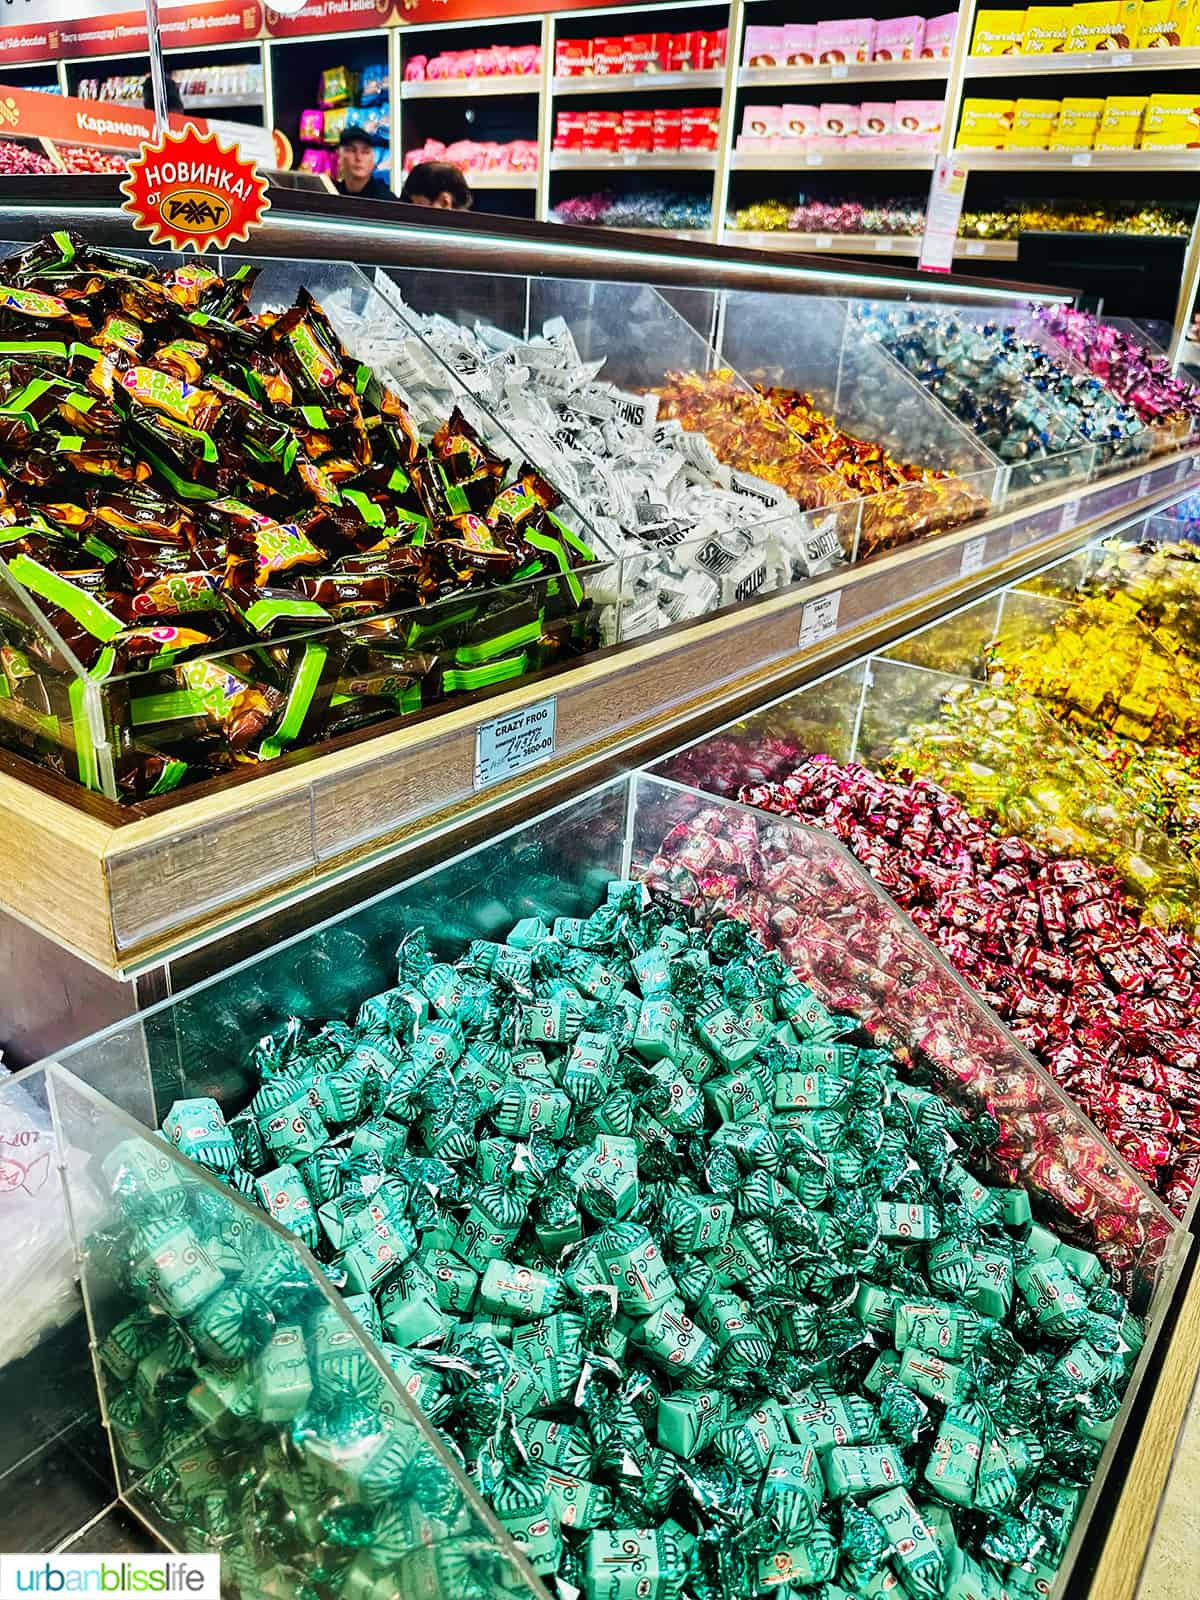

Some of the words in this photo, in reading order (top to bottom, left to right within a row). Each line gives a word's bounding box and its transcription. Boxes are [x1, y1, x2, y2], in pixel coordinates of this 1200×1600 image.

[76, 112, 149, 139] Карамель
[144, 161, 253, 202] НОВИНКА!
[495, 718, 525, 737] CRAZY
[526, 709, 548, 726] FROG
